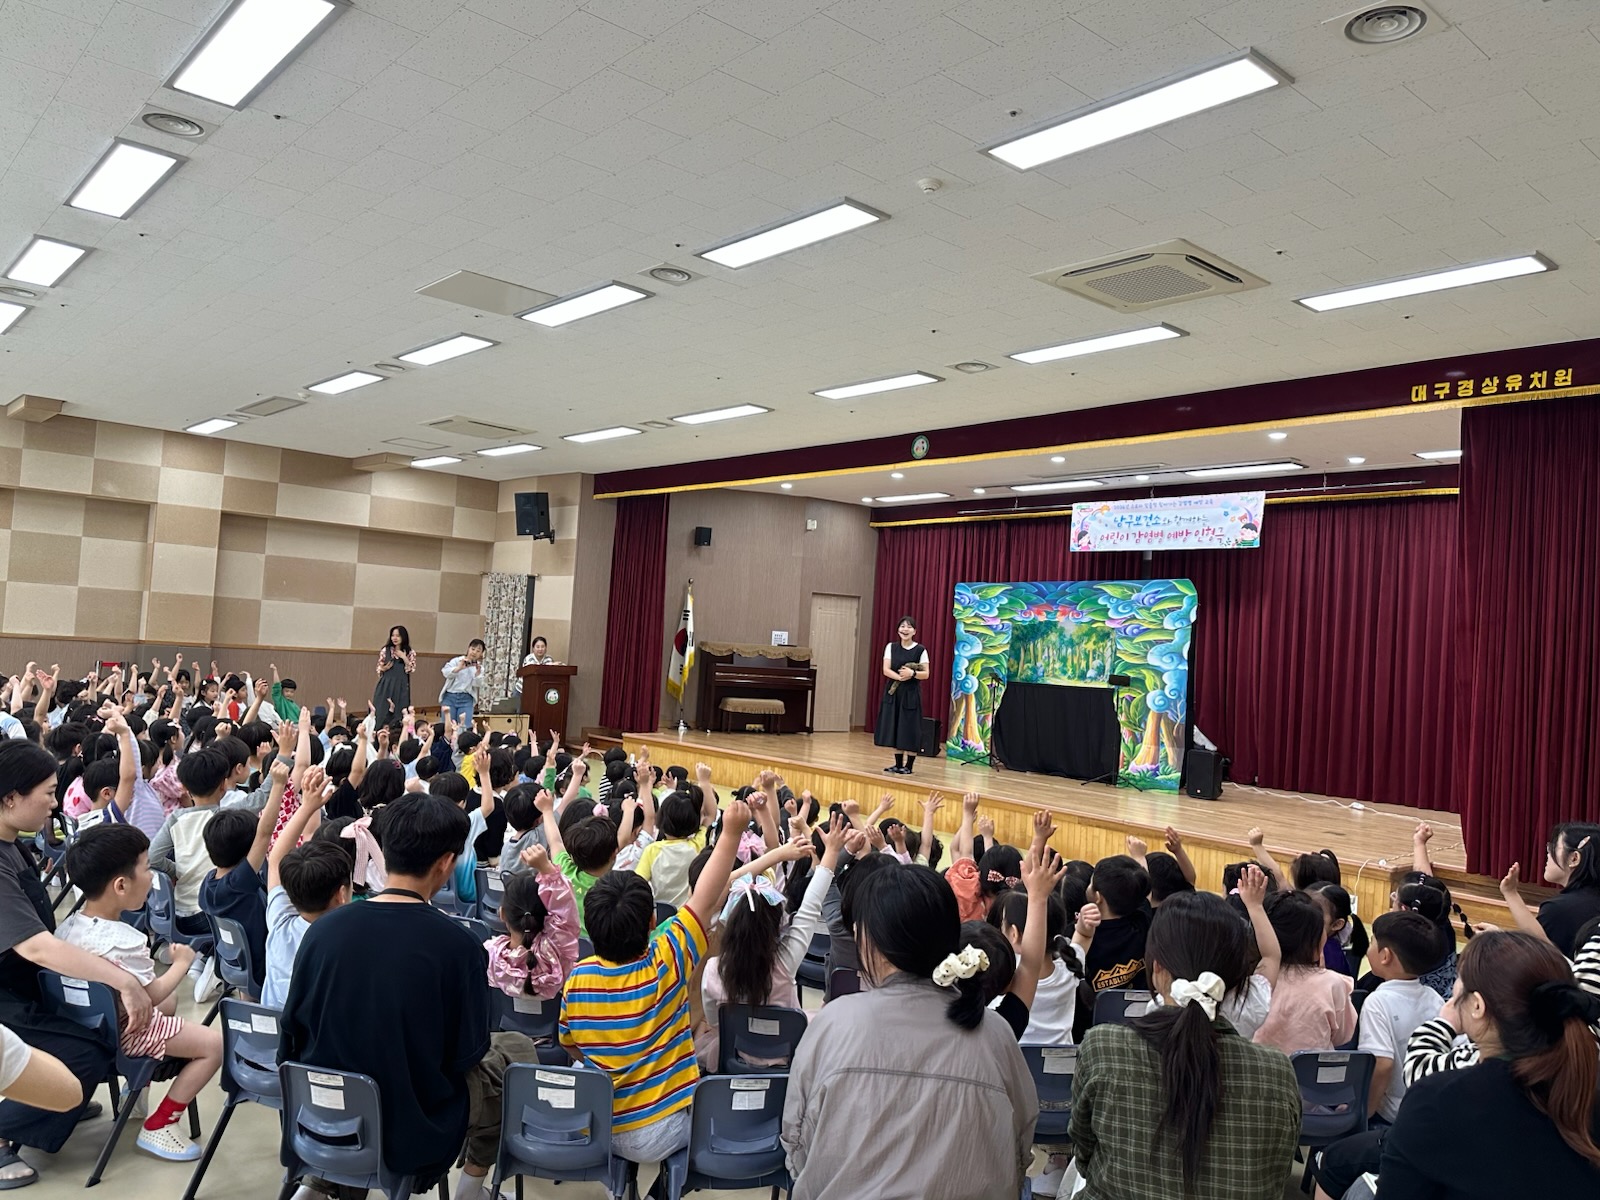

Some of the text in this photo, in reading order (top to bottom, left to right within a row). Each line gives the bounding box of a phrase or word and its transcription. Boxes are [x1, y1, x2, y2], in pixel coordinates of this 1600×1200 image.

[1411, 368, 1573, 403] 대구경상유치원
[1100, 526, 1225, 544] 어린이 감염병 예방 인형극
